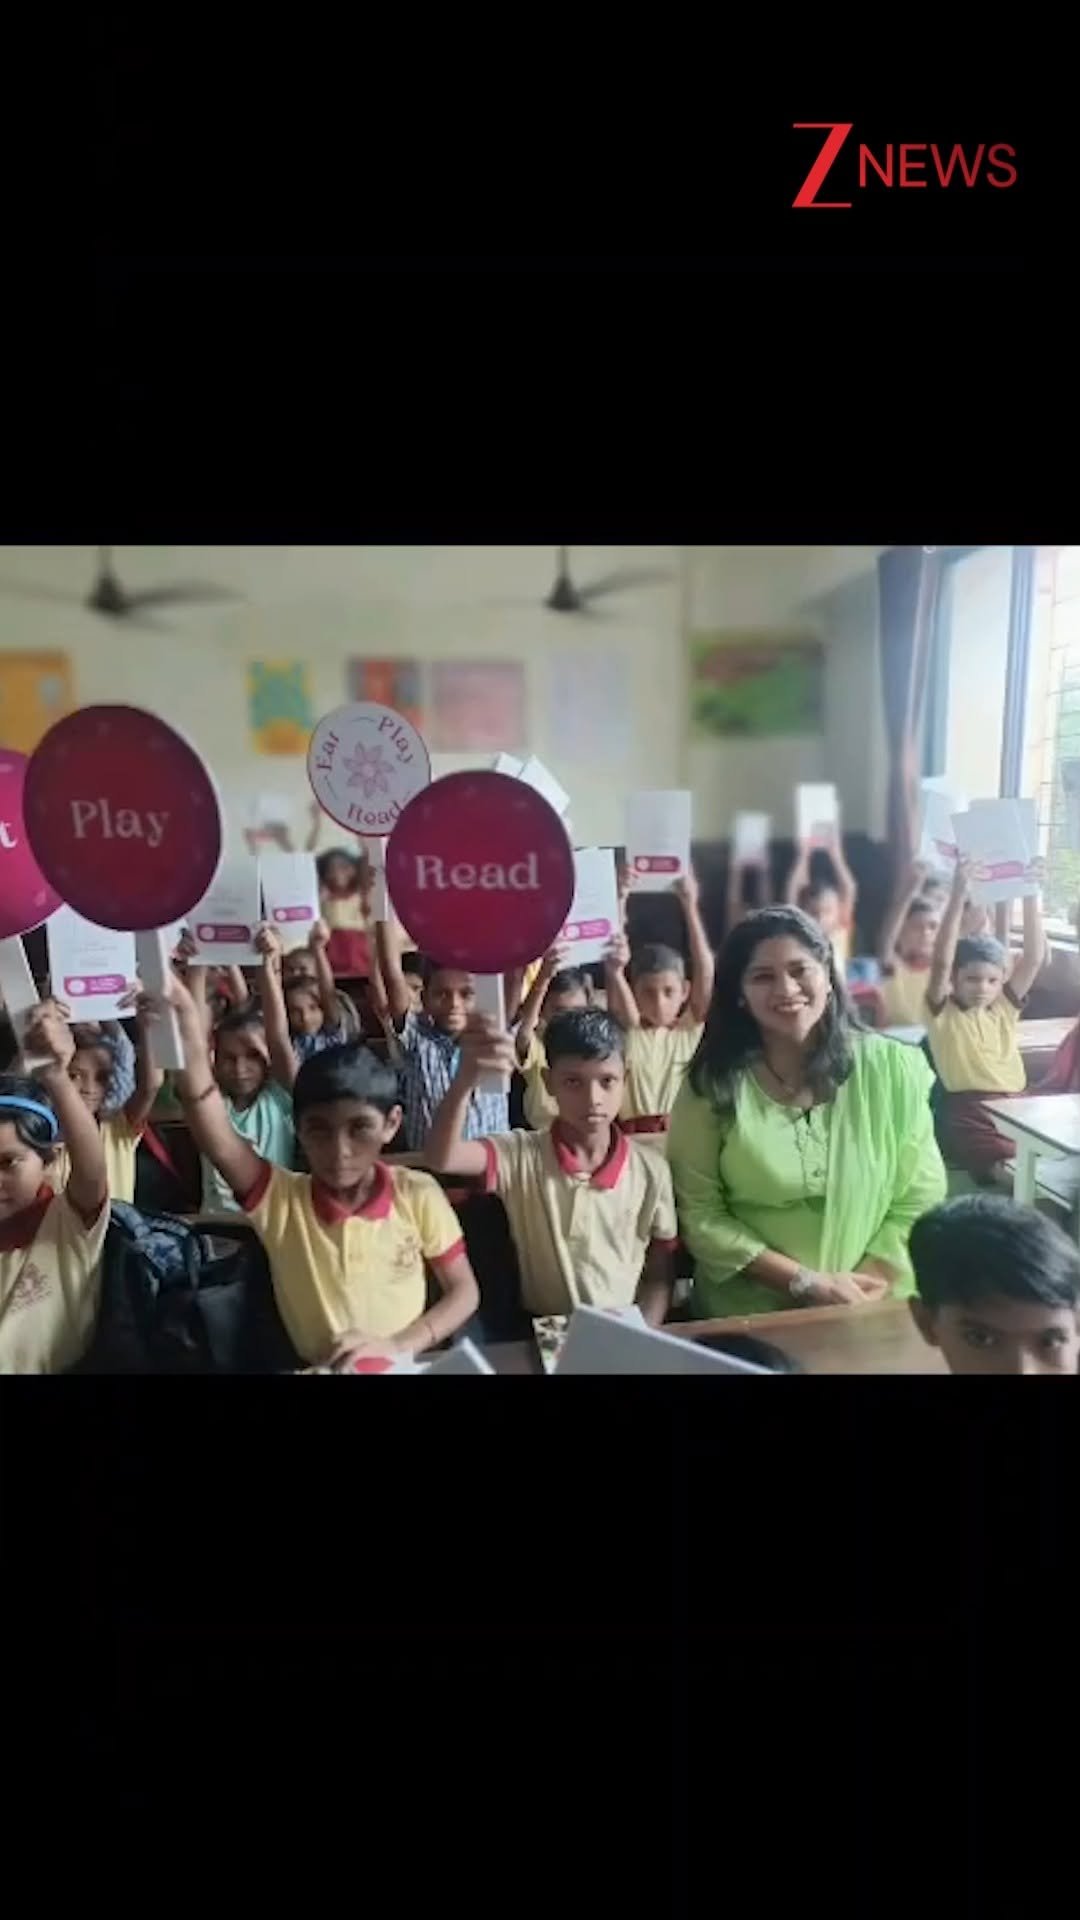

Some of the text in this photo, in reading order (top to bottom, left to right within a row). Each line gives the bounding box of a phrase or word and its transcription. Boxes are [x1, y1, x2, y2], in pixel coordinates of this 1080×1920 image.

[378, 715, 414, 764] Play
[69, 797, 171, 849] Play
[347, 799, 403, 826] Read
[415, 851, 541, 891] Read
